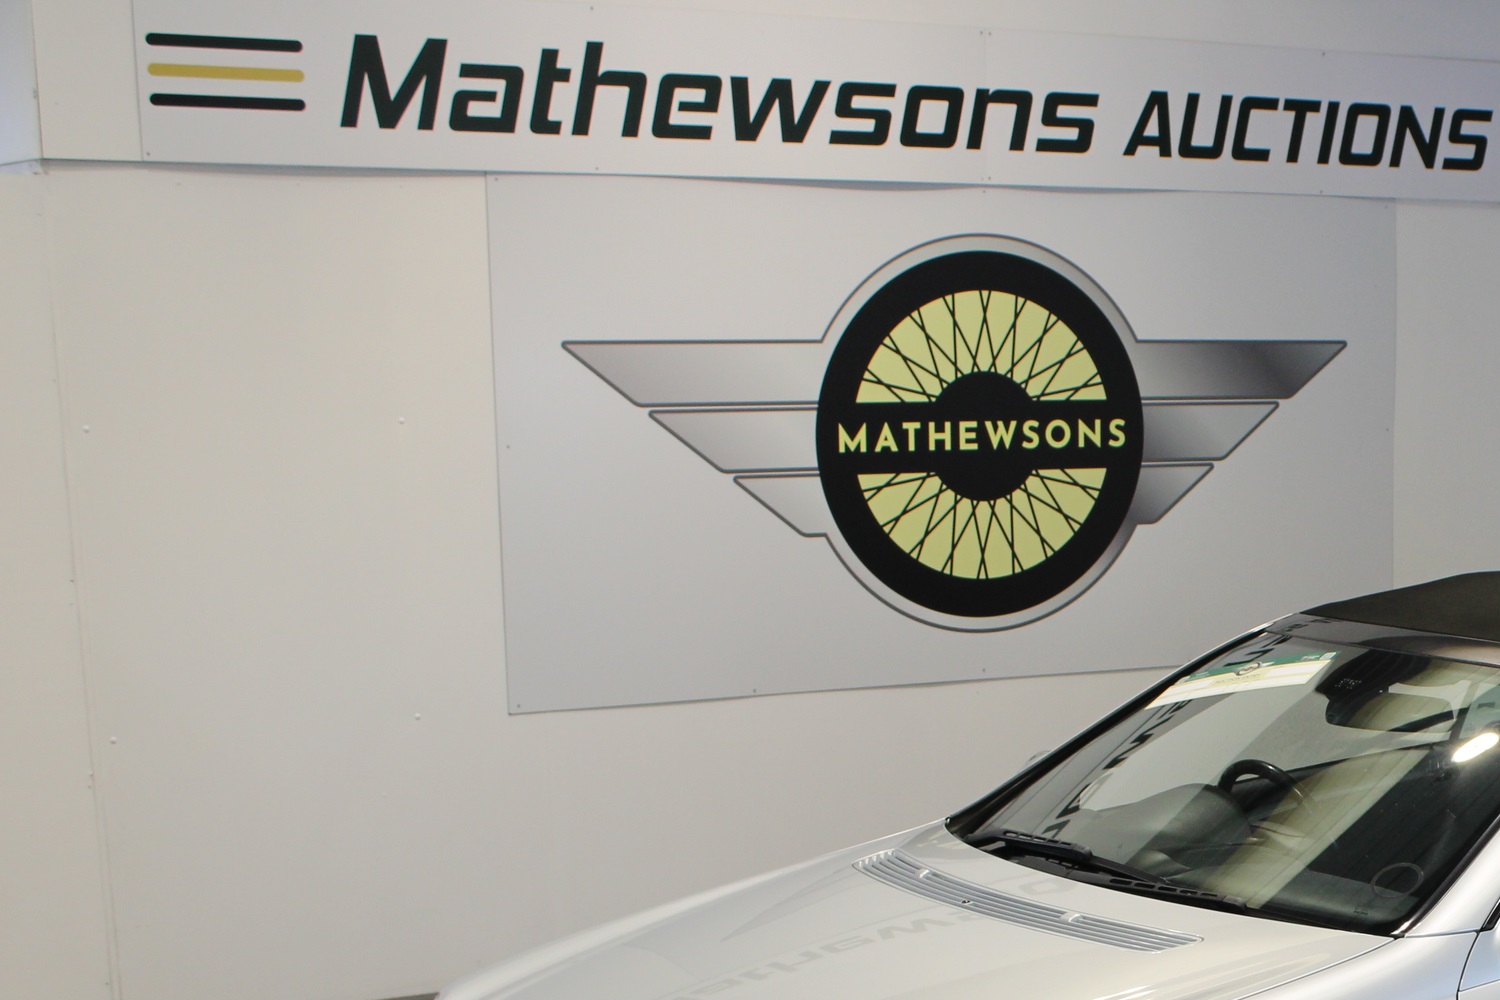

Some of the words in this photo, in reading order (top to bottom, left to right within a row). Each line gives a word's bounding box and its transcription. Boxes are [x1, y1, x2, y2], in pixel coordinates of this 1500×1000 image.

[341, 35, 1099, 153] Mathewsons
[1123, 91, 1493, 171] AUCTIONS
[839, 419, 1125, 453] MATHEWSONS
